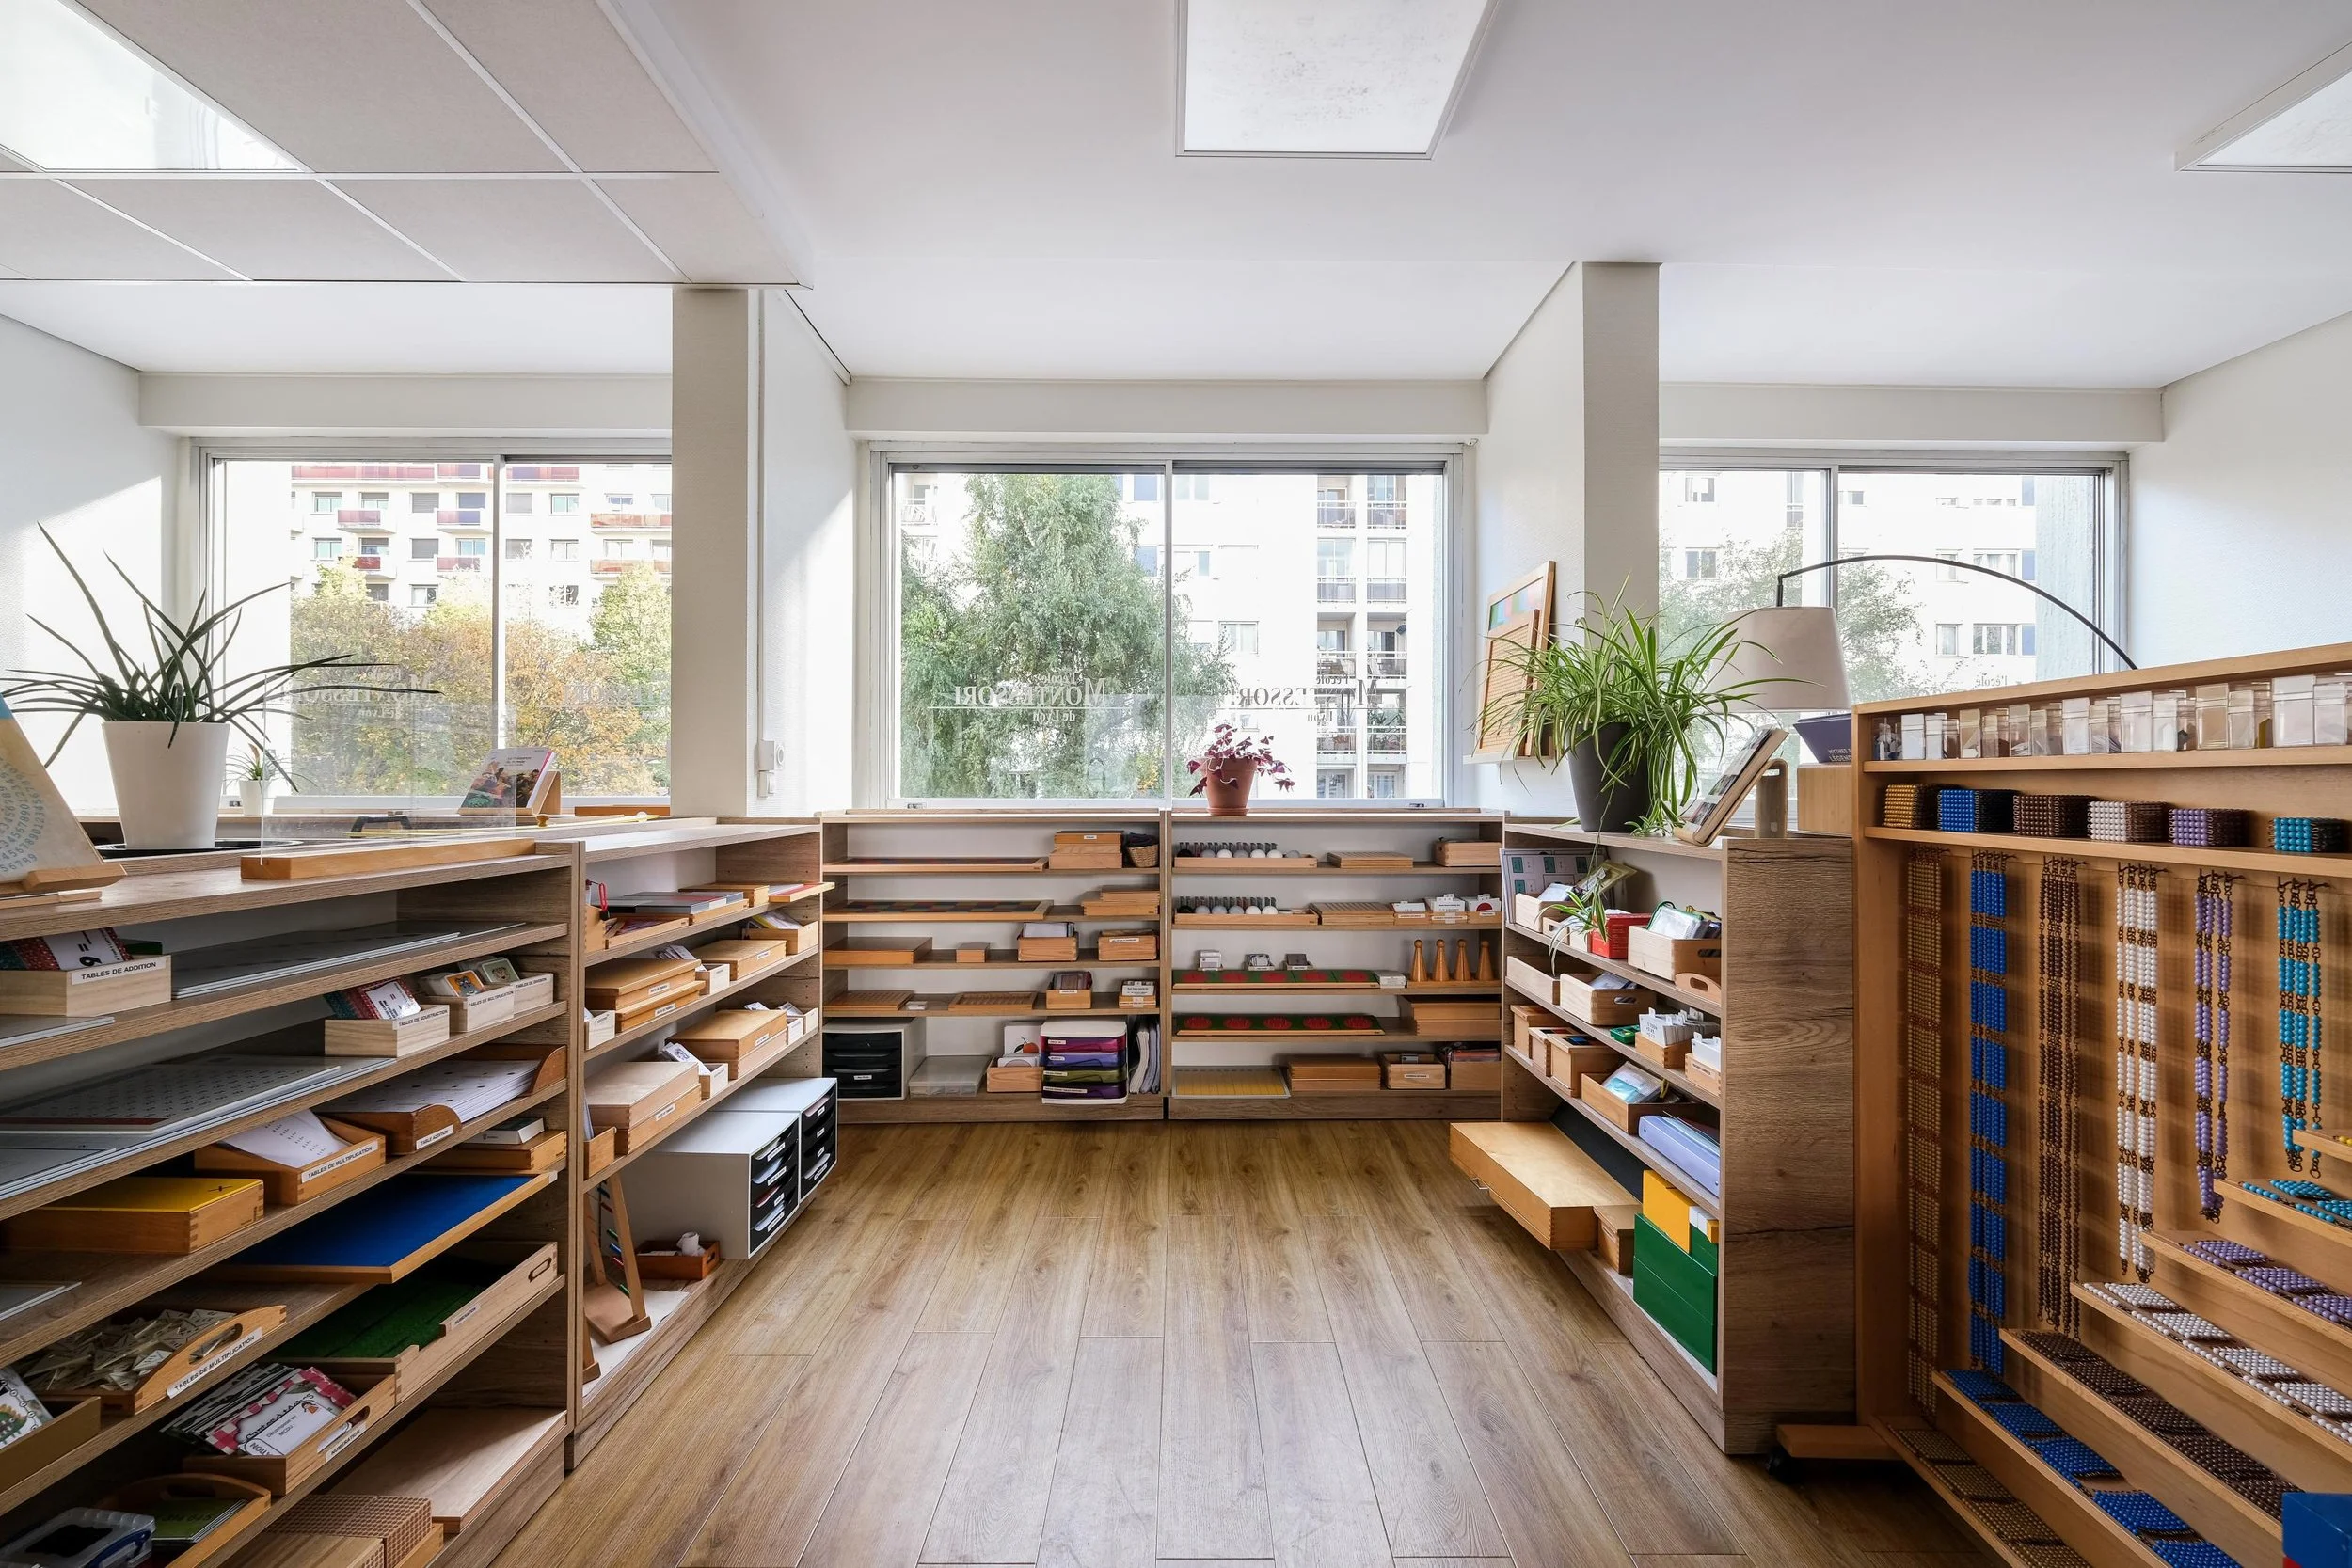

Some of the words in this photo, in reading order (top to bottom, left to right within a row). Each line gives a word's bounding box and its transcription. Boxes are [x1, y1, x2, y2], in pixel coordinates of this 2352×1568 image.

[81, 970, 111, 980] TABLES
[123, 961, 156, 973] ADDITION
[487, 990, 514, 1002] MULTIPLICATION
[432, 1130, 449, 1141] ADDITION
[308, 1165, 327, 1179] TABLES
[327, 1162, 335, 1170] DE
[335, 1146, 373, 1165] MULTIPLICATION
[174, 1370, 199, 1391] TABLES
[199, 1366, 208, 1376] DE
[208, 1335, 256, 1370] MULTIPLICATION
[331, 1430, 360, 1455] NUMERATION
